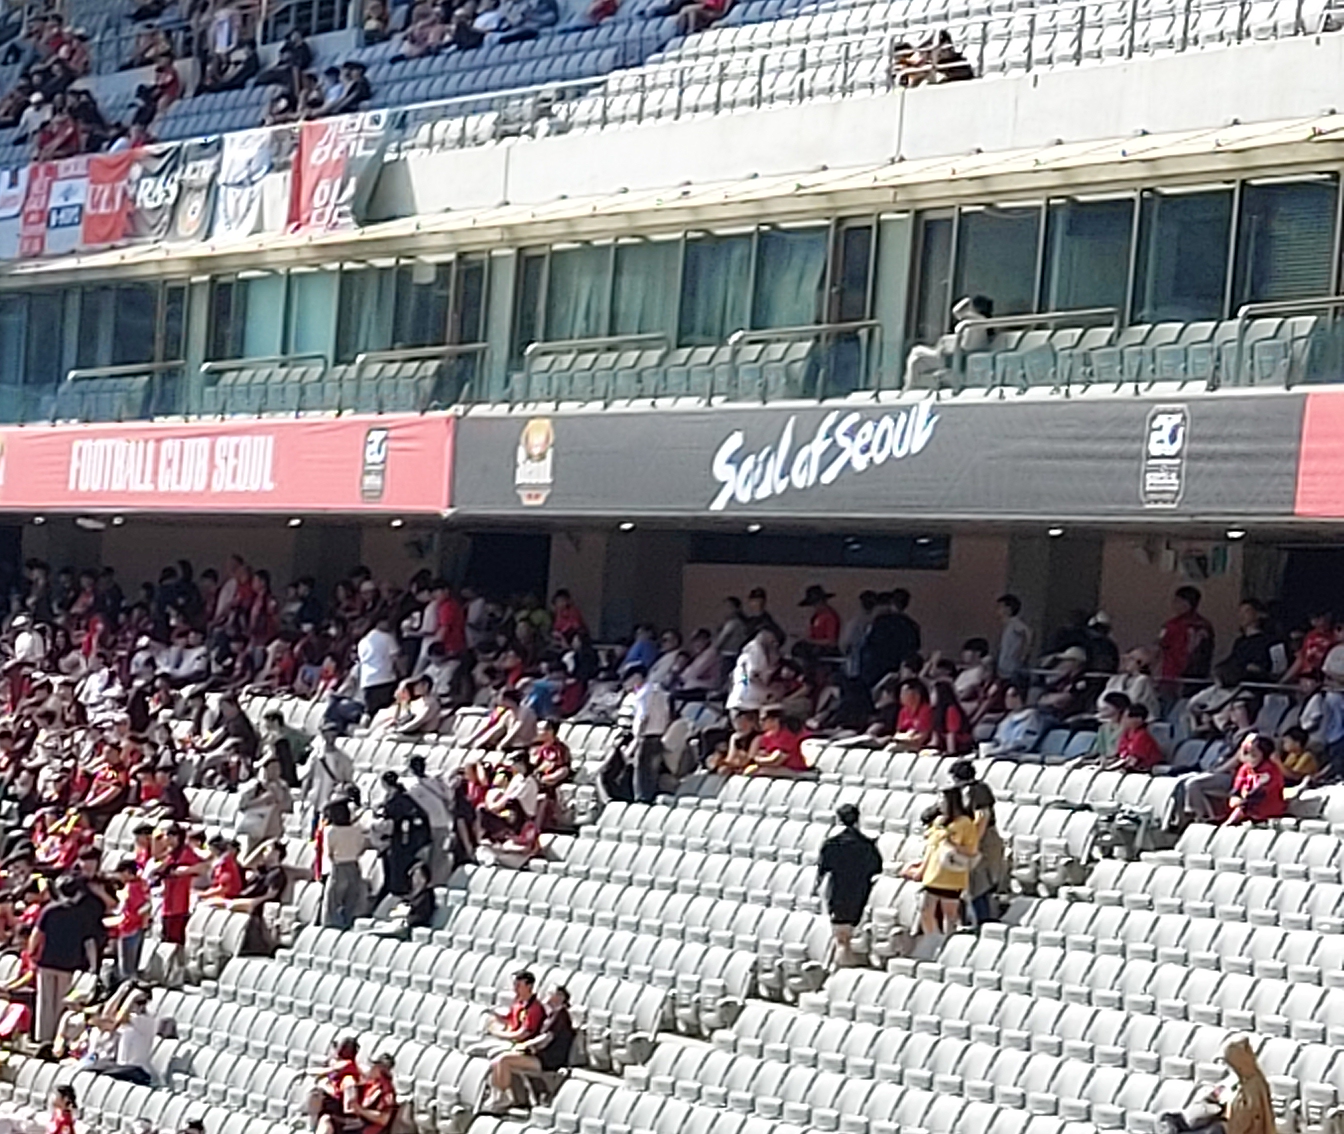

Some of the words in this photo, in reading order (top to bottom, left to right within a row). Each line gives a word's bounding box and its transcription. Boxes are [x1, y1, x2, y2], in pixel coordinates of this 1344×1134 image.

[68, 438, 156, 492] FOOTBALL
[157, 437, 211, 492] CLUB
[212, 435, 275, 492] SEOUL
[708, 414, 798, 511] Soul
[819, 398, 941, 486] Seoul
